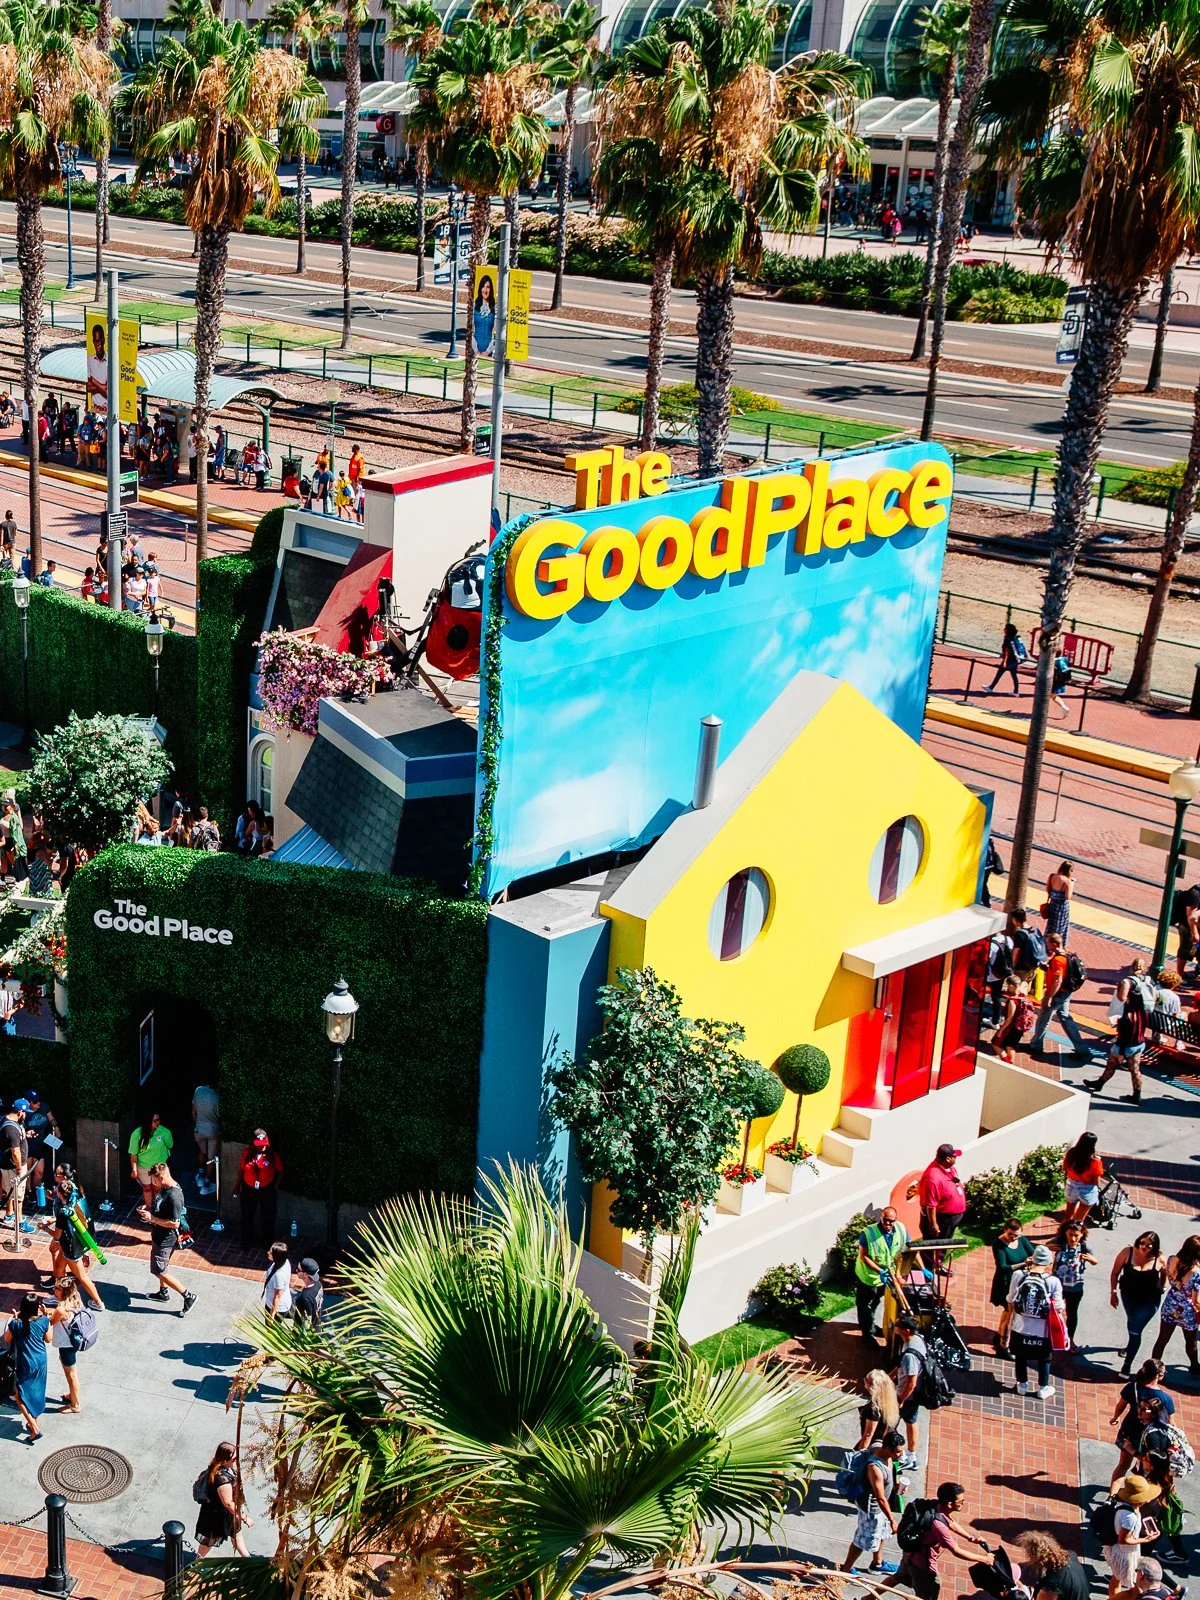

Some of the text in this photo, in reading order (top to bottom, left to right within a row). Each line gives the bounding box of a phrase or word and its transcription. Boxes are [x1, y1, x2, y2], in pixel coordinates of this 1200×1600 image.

[439, 224, 451, 236] 18
[509, 309, 527, 318] Good
[509, 316, 527, 325] Place
[120, 365, 136, 374] Good
[120, 372, 136, 382] Place
[565, 445, 672, 511] The
[113, 899, 148, 917] The
[93, 909, 234, 945] Good Place
[1022, 1338, 1043, 1347] LANG
